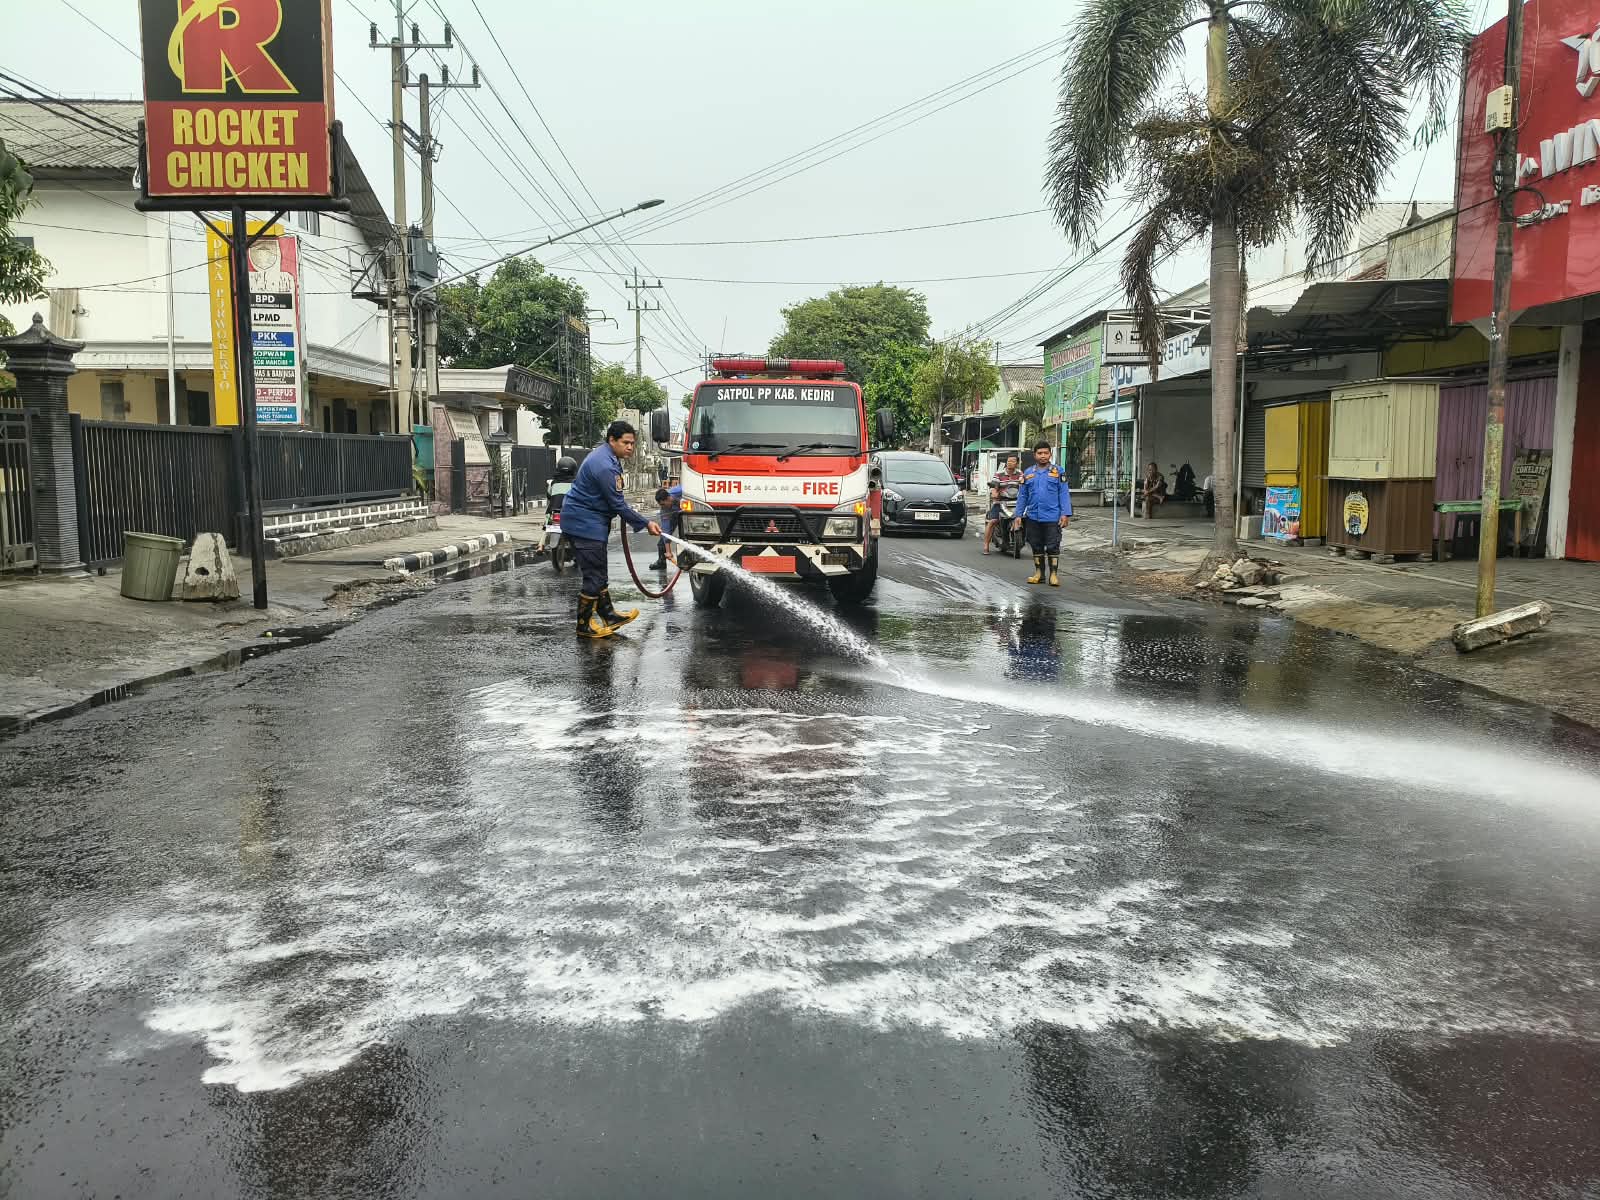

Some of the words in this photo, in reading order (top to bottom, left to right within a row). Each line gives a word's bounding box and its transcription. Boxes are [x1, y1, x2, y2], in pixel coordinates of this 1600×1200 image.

[172, 108, 299, 146] ROCKET
[166, 151, 309, 188] CHICKEN
[213, 238, 224, 281] DESA
[255, 294, 276, 303] BPD
[253, 313, 281, 322] LPMD
[257, 332, 278, 340] PKK
[717, 387, 755, 401] SATPOL
[757, 387, 772, 400] PP
[774, 387, 798, 400] KAB.
[800, 388, 835, 402] KEDIRI
[802, 481, 839, 495] FIRE
